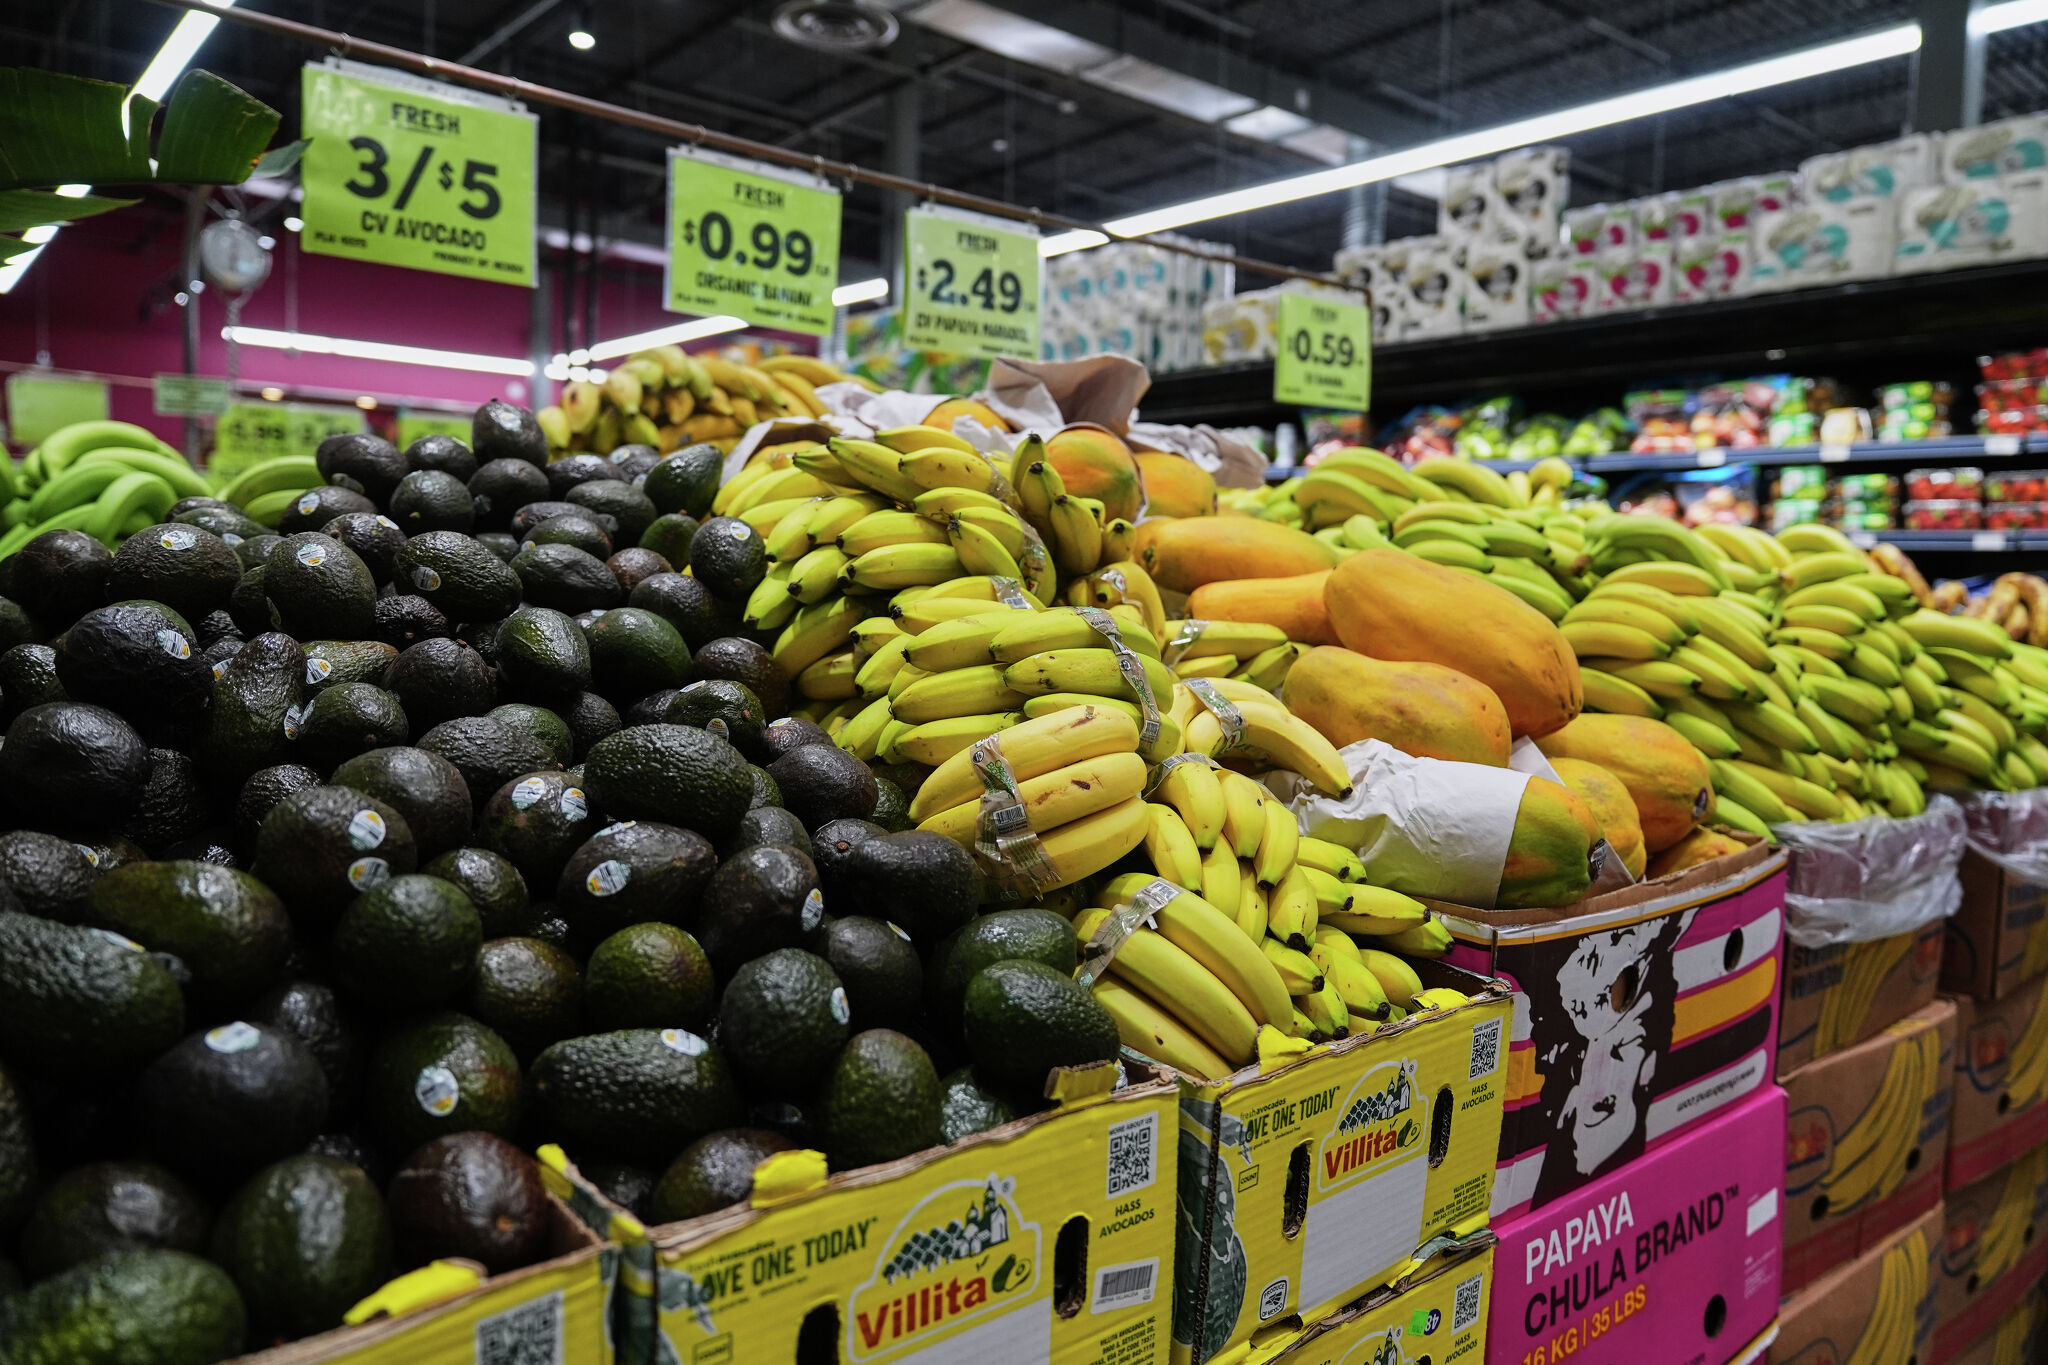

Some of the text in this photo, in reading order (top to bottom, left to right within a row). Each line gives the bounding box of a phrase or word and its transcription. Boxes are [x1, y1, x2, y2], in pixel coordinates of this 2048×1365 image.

[391, 103, 461, 134] FRESH
[345, 135, 503, 220] 3/$5
[734, 182, 785, 208] FRESH
[361, 211, 389, 234] CV
[394, 217, 487, 250] AVOCADO
[683, 211, 813, 277] $0.99
[957, 230, 998, 252] FRESH
[695, 271, 813, 307] ORGANIC BANANA
[917, 258, 1022, 314] $2.49
[935, 315, 978, 336] PAPAYA
[1460, 1090, 1495, 1112] AVOCADOS
[1471, 1082, 1488, 1096] HASS
[1271, 1103, 1297, 1133] ONE
[1099, 1208, 1155, 1239] AVOCADOS
[1115, 1198, 1142, 1218] HASS
[1526, 1191, 1635, 1285] PAPAYA
[752, 1244, 796, 1286] ONE
[1524, 1248, 1627, 1338] CHULA
[1551, 1327, 1578, 1364] KG
[1591, 1306, 1611, 1339] 35
[1614, 1283, 1647, 1324] LBS
[1444, 1338, 1478, 1365] AVOCADOS
[1454, 1332, 1471, 1348] HASS
